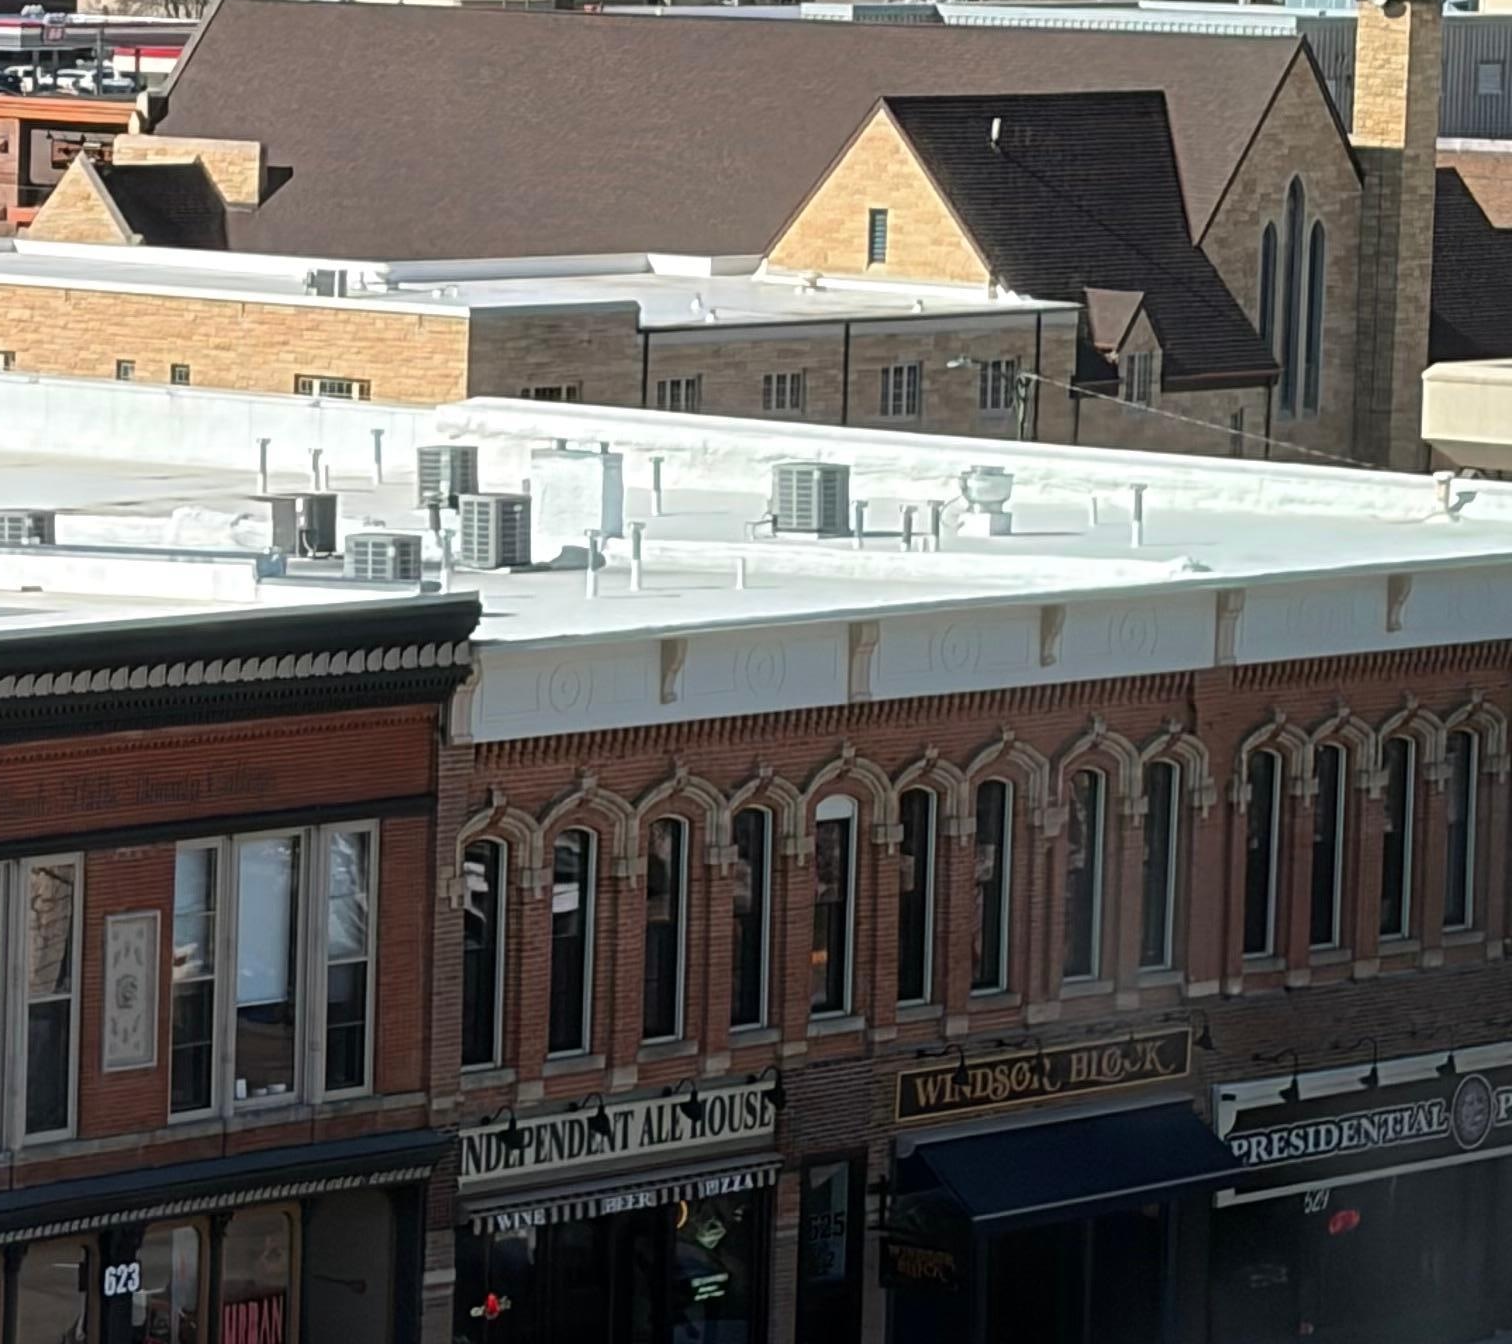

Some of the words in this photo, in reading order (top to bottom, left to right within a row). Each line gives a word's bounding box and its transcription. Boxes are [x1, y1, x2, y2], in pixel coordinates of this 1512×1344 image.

[639, 1102, 683, 1147] ALE
[1230, 1101, 1449, 1167] PRESIDENTIAL
[496, 1207, 547, 1233] WINE
[605, 1190, 652, 1214] BEER
[705, 1174, 753, 1198] PIZZA
[103, 1261, 141, 1297] 623
